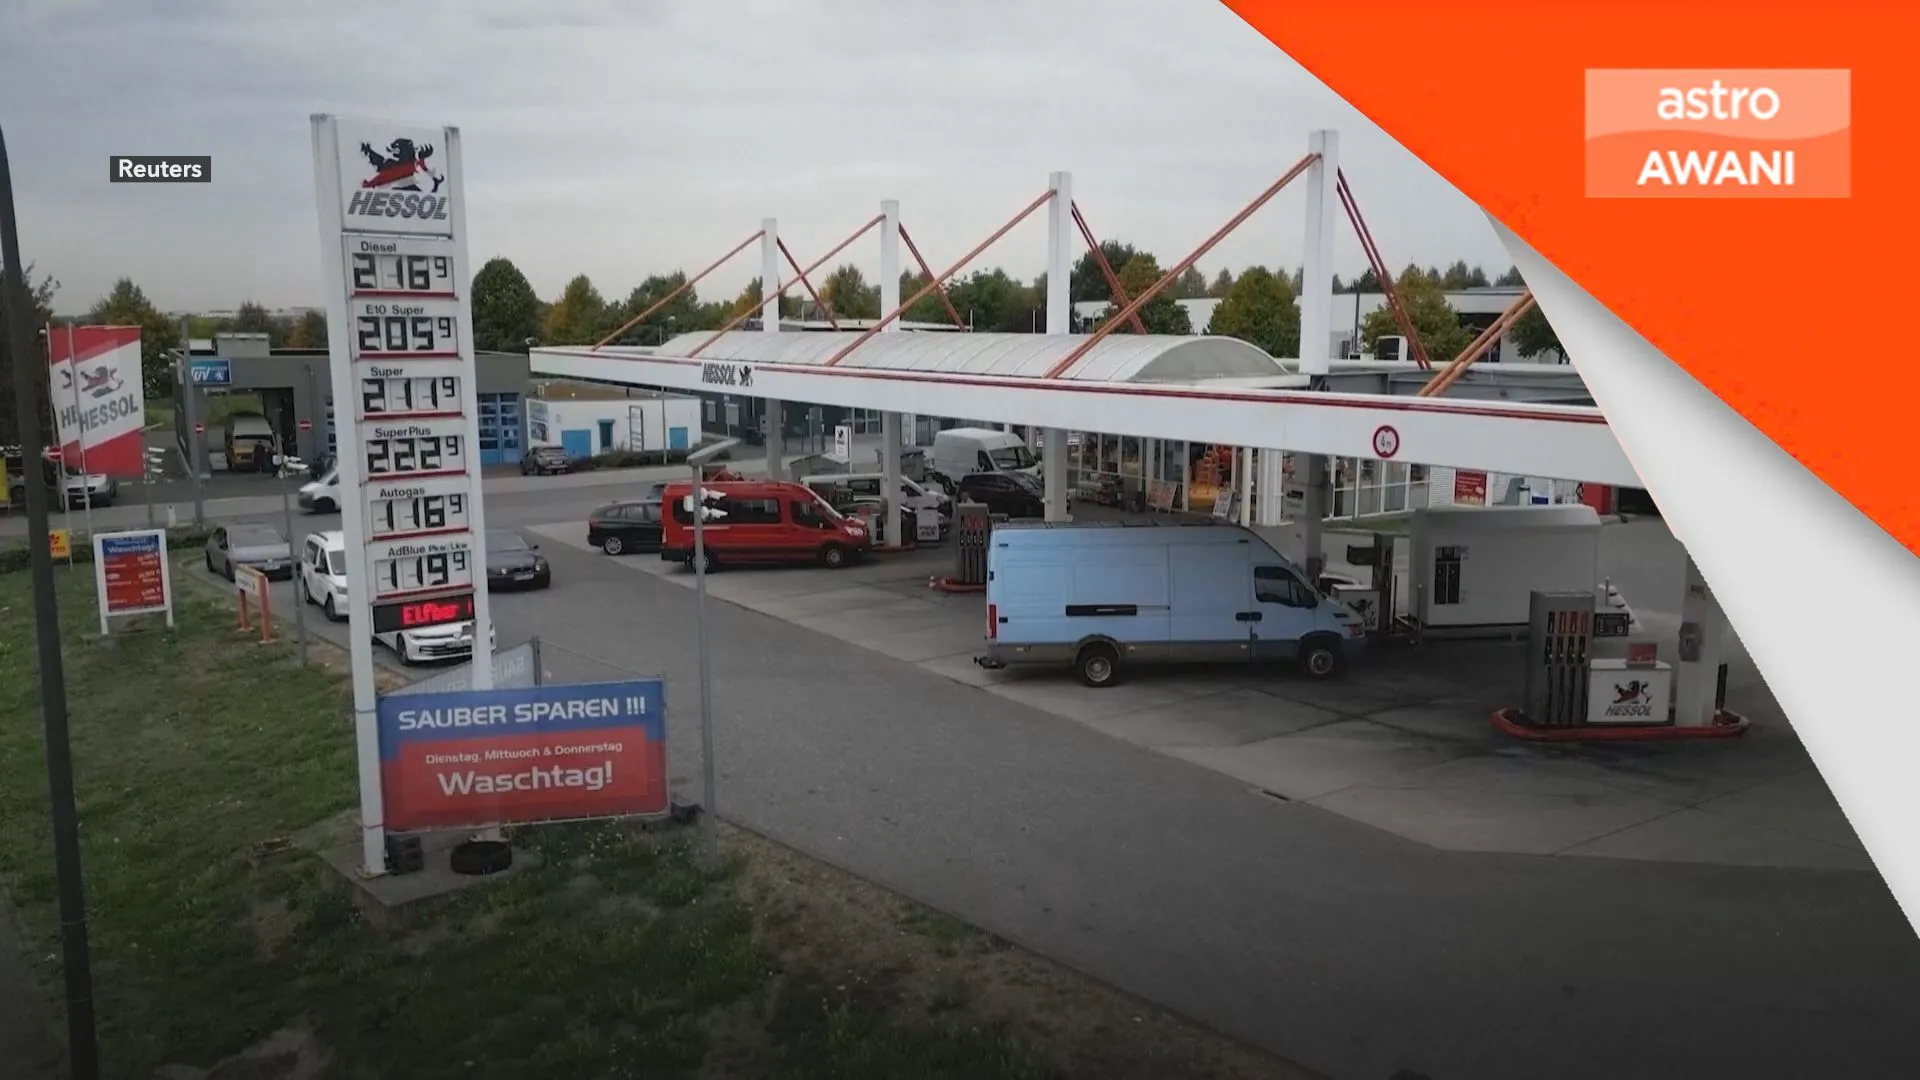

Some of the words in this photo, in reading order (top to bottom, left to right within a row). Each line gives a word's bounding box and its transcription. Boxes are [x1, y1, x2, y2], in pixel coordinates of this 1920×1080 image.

[347, 190, 447, 221] HESSOL
[360, 241, 397, 253] Diesel
[366, 304, 387, 315] E10
[391, 305, 425, 317] Super
[370, 367, 404, 377] Super
[702, 363, 736, 385] HESSOL
[79, 393, 139, 433] HESSOL
[380, 488, 426, 499] Autogas
[388, 545, 426, 557] AdBlue
[398, 705, 507, 730] SAUBER
[515, 697, 618, 723] SPAREN
[626, 696, 646, 715] !!!
[1604, 705, 1652, 717] HESSOL
[425, 752, 482, 765] Dienstag,
[485, 747, 540, 761] Mittwoch
[543, 746, 552, 756] &
[555, 742, 623, 756] Donnerstag
[438, 760, 612, 797] Waschtag!
